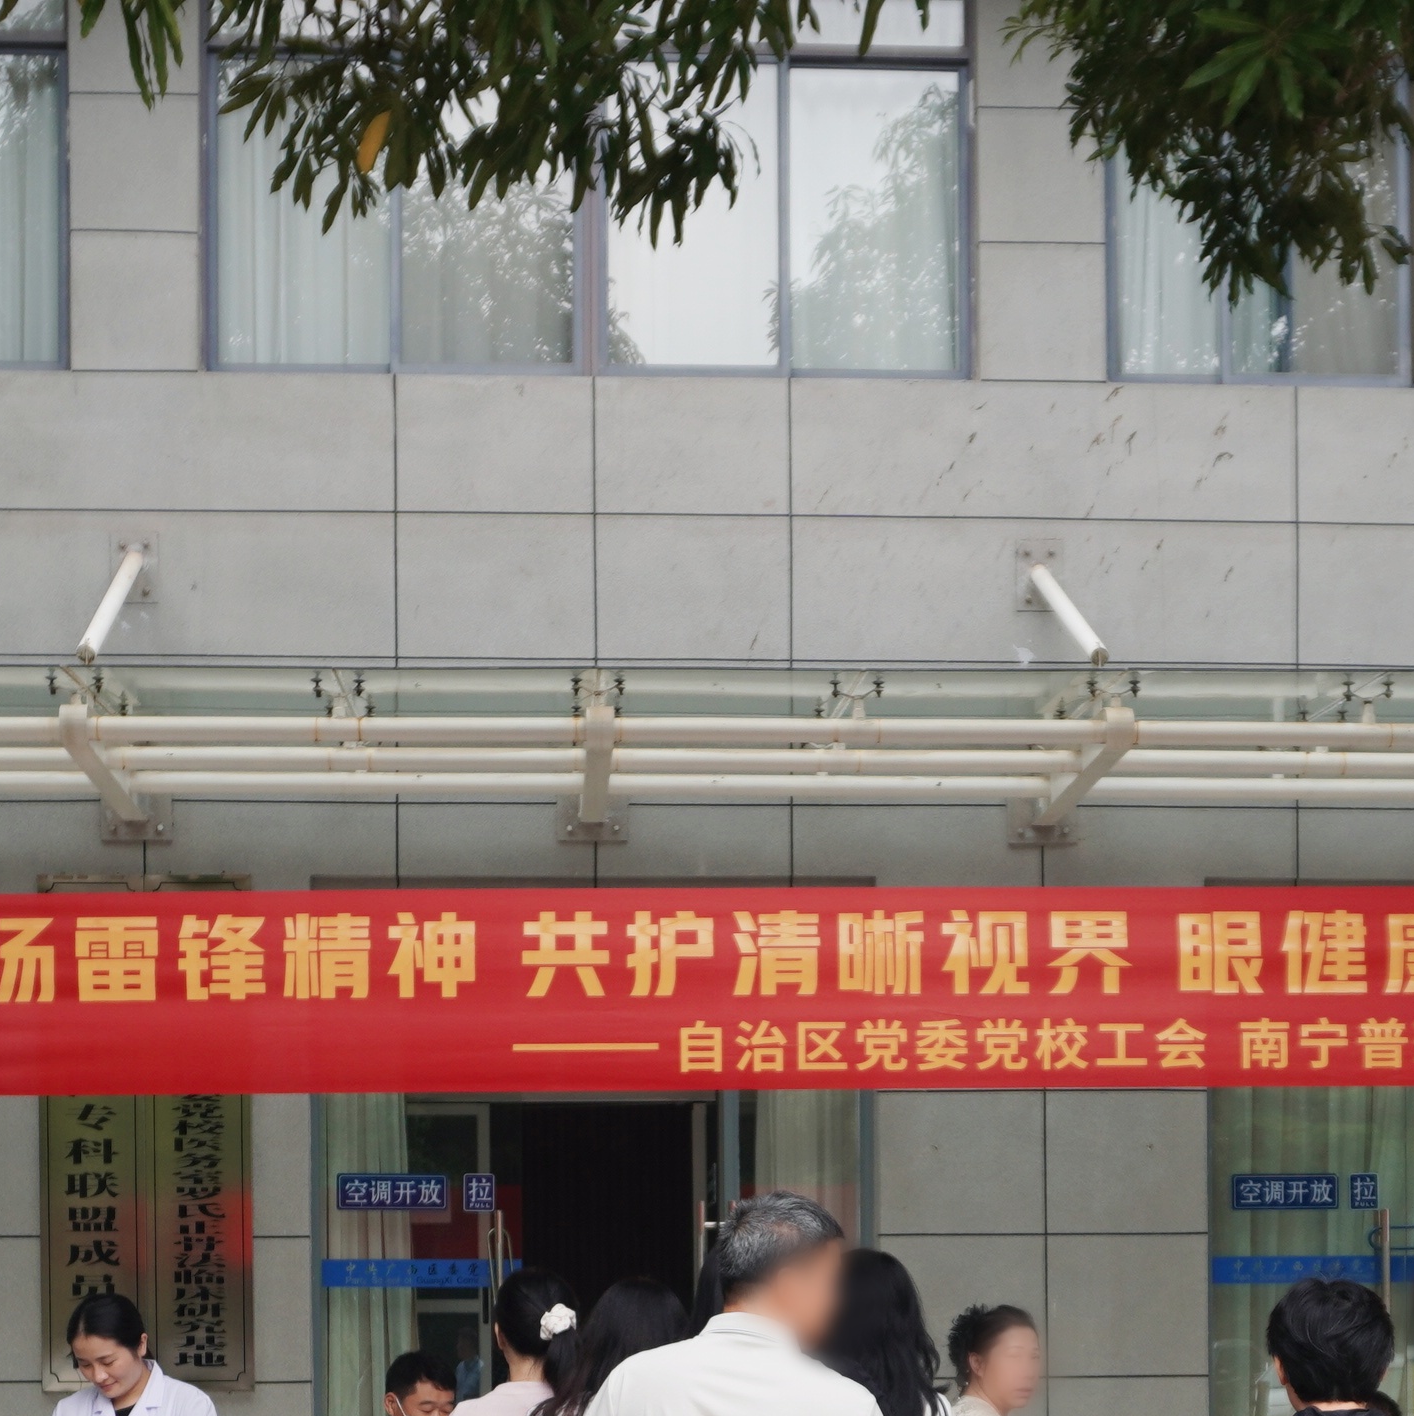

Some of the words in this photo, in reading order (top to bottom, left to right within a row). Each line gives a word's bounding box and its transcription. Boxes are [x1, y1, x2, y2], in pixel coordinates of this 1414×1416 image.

[522, 911, 1131, 1000] 共护清晰视界
[345, 1179, 442, 1205] 空调开放
[468, 1178, 492, 1202] 拉
[1240, 1180, 1333, 1205] 空调开放
[1353, 1177, 1376, 1200] 拉
[65, 1103, 120, 1300] 专科联盟成员
